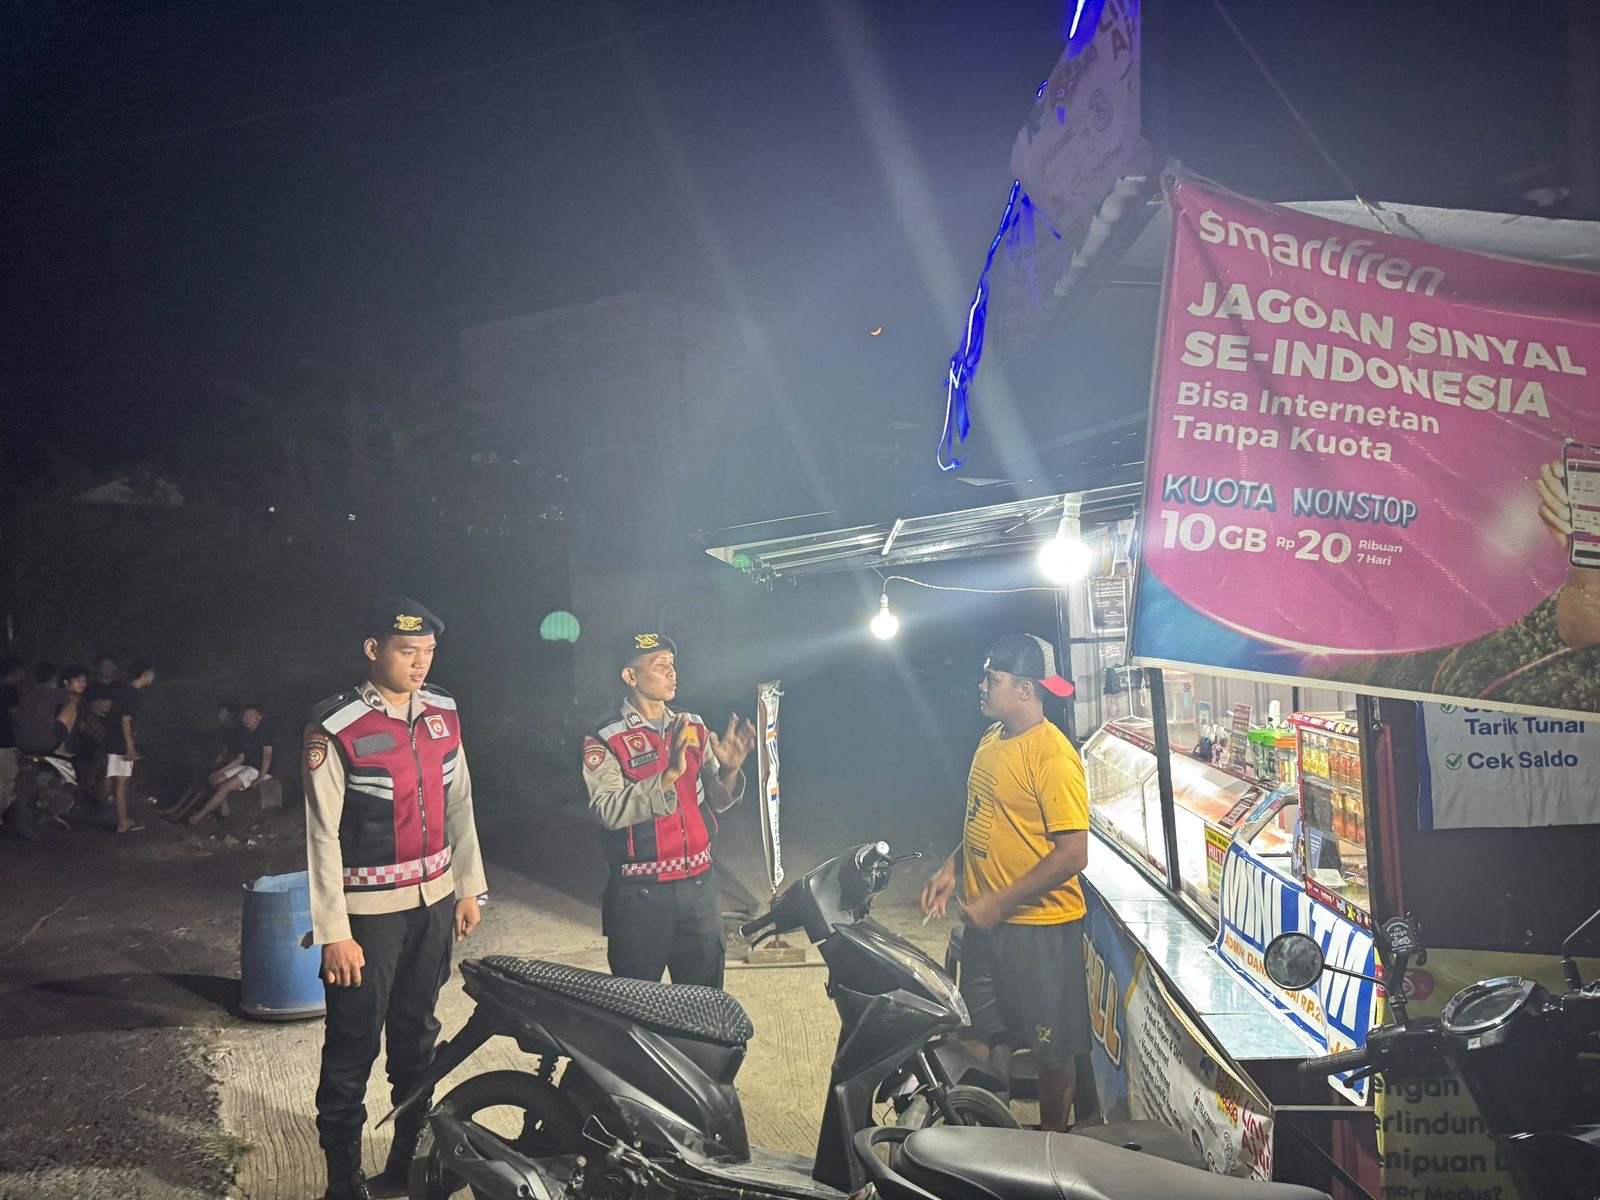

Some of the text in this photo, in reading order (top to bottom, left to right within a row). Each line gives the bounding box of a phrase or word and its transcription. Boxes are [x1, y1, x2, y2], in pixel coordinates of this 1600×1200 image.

[1198, 209, 1446, 297] smartfren
[1187, 282, 1588, 376] JAGOAN SINYAL
[1180, 331, 1551, 418] SE-INDONESIA
[1178, 381, 1440, 435] Bisa Internetan
[1173, 414, 1392, 463] Tanpa Kuota
[1162, 473, 1419, 528] KUOTA NONSTOP
[1356, 553, 1392, 566] 7 Hari
[1358, 539, 1404, 554] Ribuan
[1464, 717, 1519, 735] Tarik
[1467, 750, 1579, 770] Cek Saldo
[1208, 842, 1225, 866] HUT
